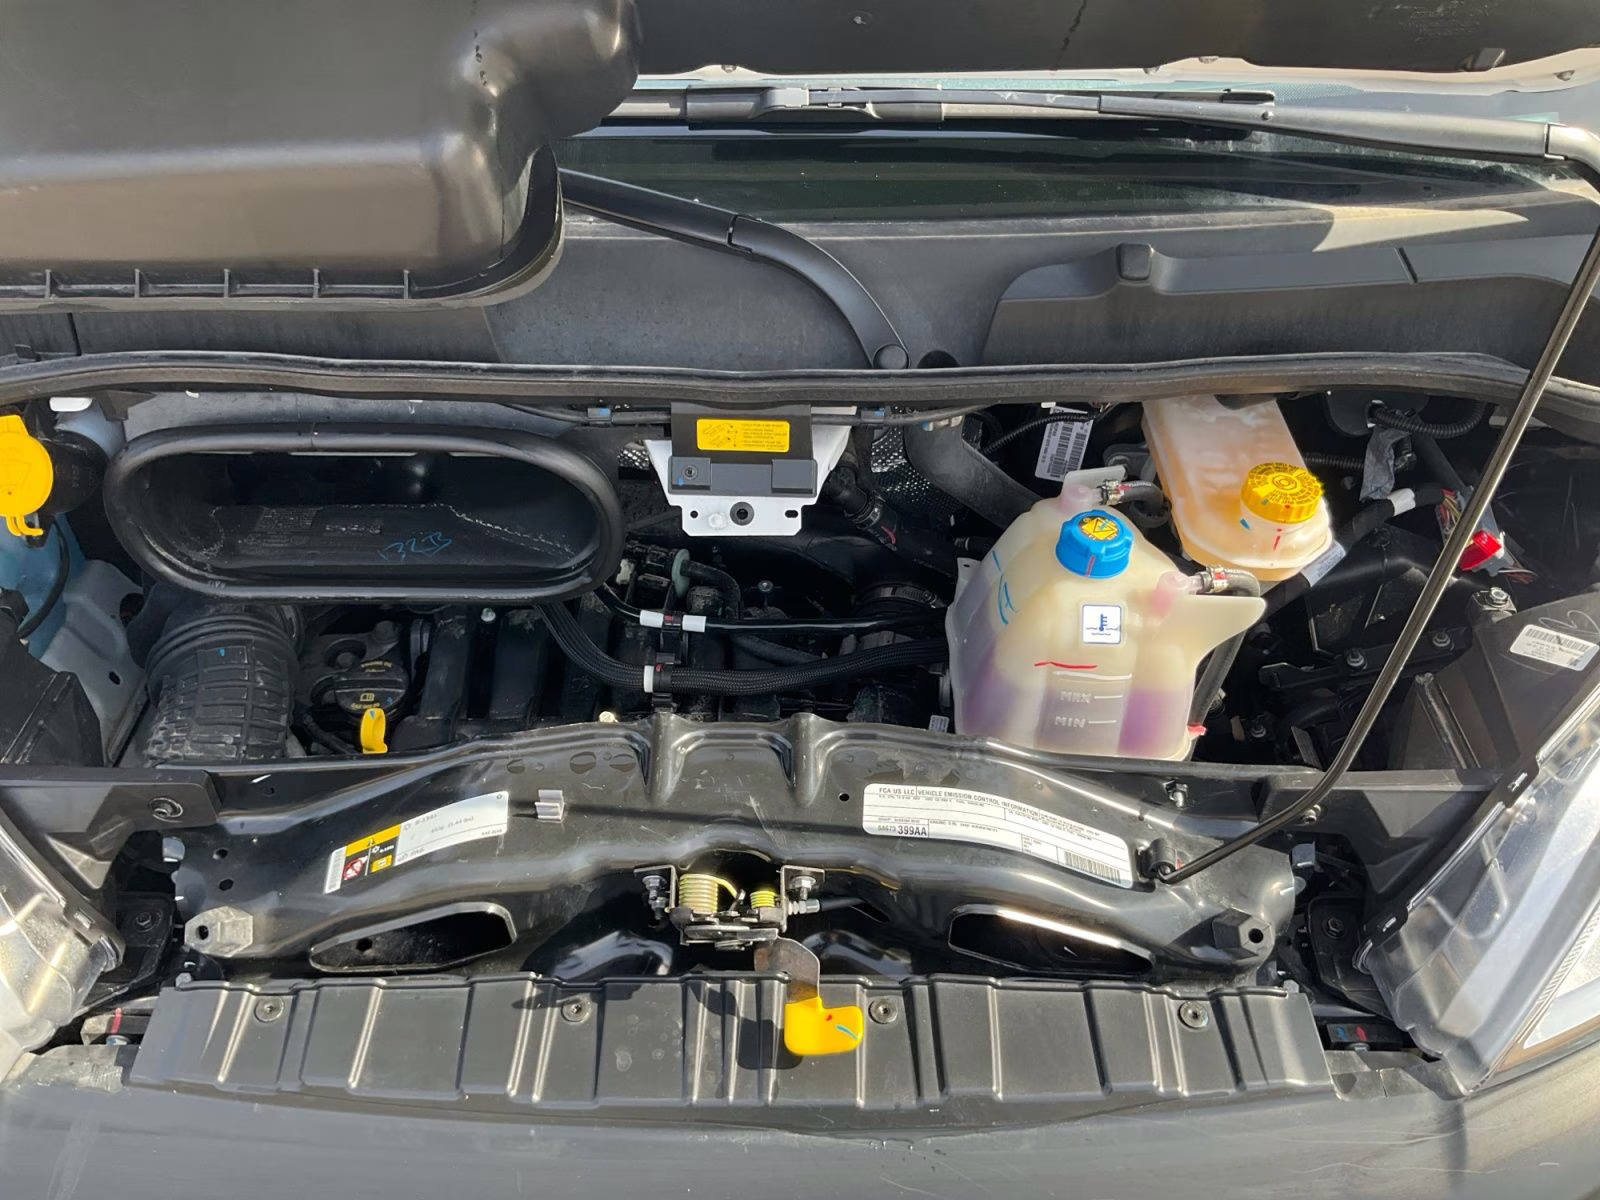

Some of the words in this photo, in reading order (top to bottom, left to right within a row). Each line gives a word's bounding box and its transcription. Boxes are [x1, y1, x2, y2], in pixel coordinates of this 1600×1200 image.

[1060, 690, 1092, 704] MAX
[1054, 715, 1086, 728] MIN
[917, 789, 943, 797] VEHICLE
[944, 792, 972, 800] EMISSION
[973, 795, 1000, 806] CONTROL
[1002, 801, 1039, 816] INFORMATION
[897, 824, 928, 836] 399AA
